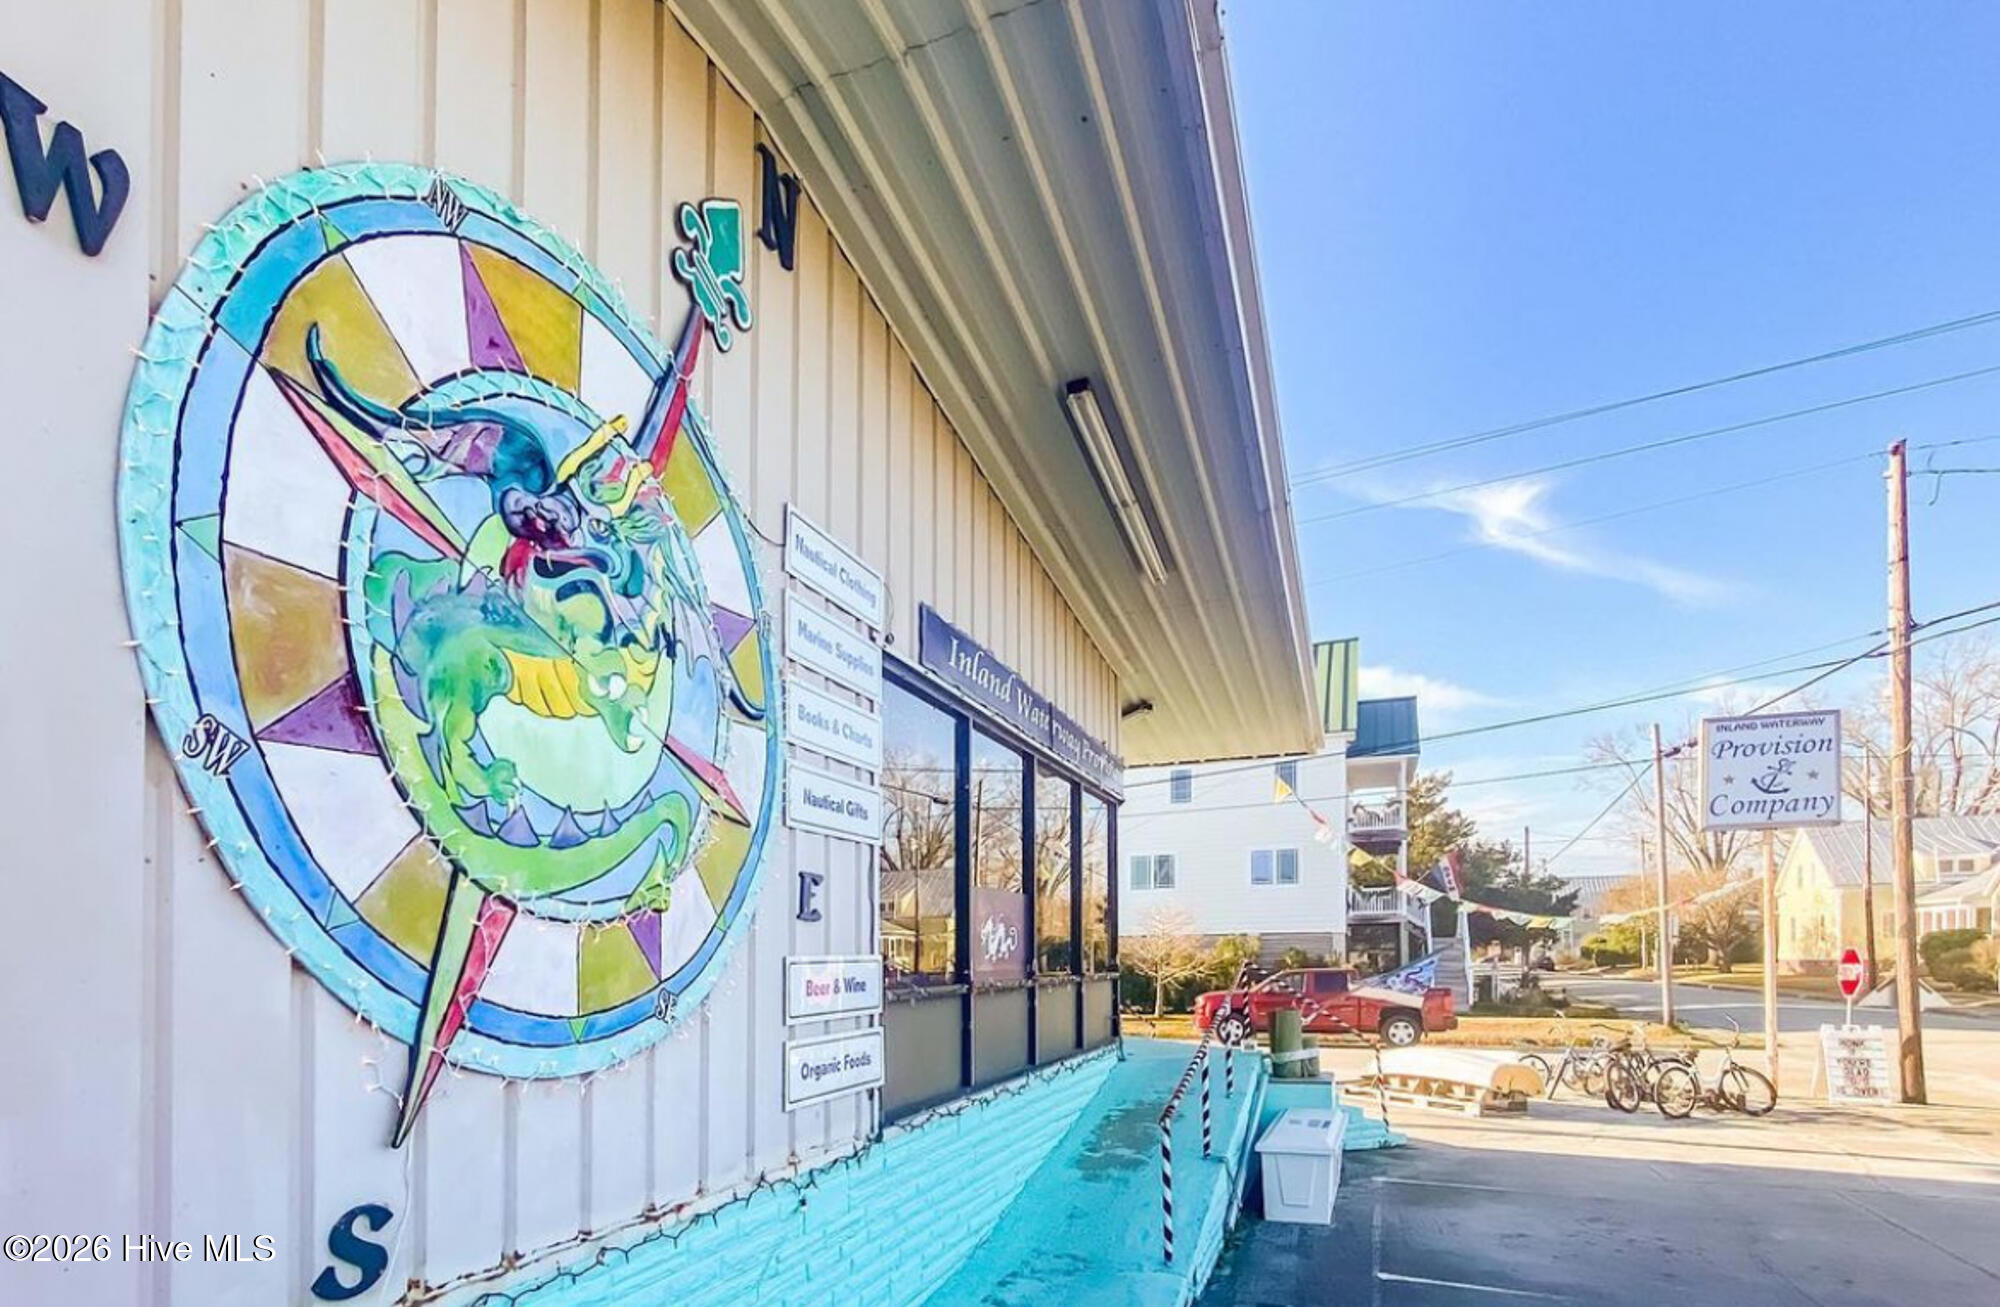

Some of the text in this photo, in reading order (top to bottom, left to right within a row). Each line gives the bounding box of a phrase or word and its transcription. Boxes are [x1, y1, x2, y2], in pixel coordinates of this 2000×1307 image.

[0, 71, 130, 257] W
[755, 142, 802, 272] N
[795, 533, 877, 609] Nautical Clothing
[948, 635, 1017, 703] Inland
[182, 713, 252, 776] SW
[797, 703, 873, 749] Books & Charts
[1711, 733, 1833, 760] Provision
[1716, 716, 1826, 733] INLAND WATERWAY
[803, 787, 869, 821] Nautical Gifts
[1709, 793, 1835, 821] Company
[796, 871, 824, 922] E
[805, 976, 867, 998] Beer & Wine
[801, 1052, 872, 1082] Organic Foods
[311, 1203, 394, 1301] S
